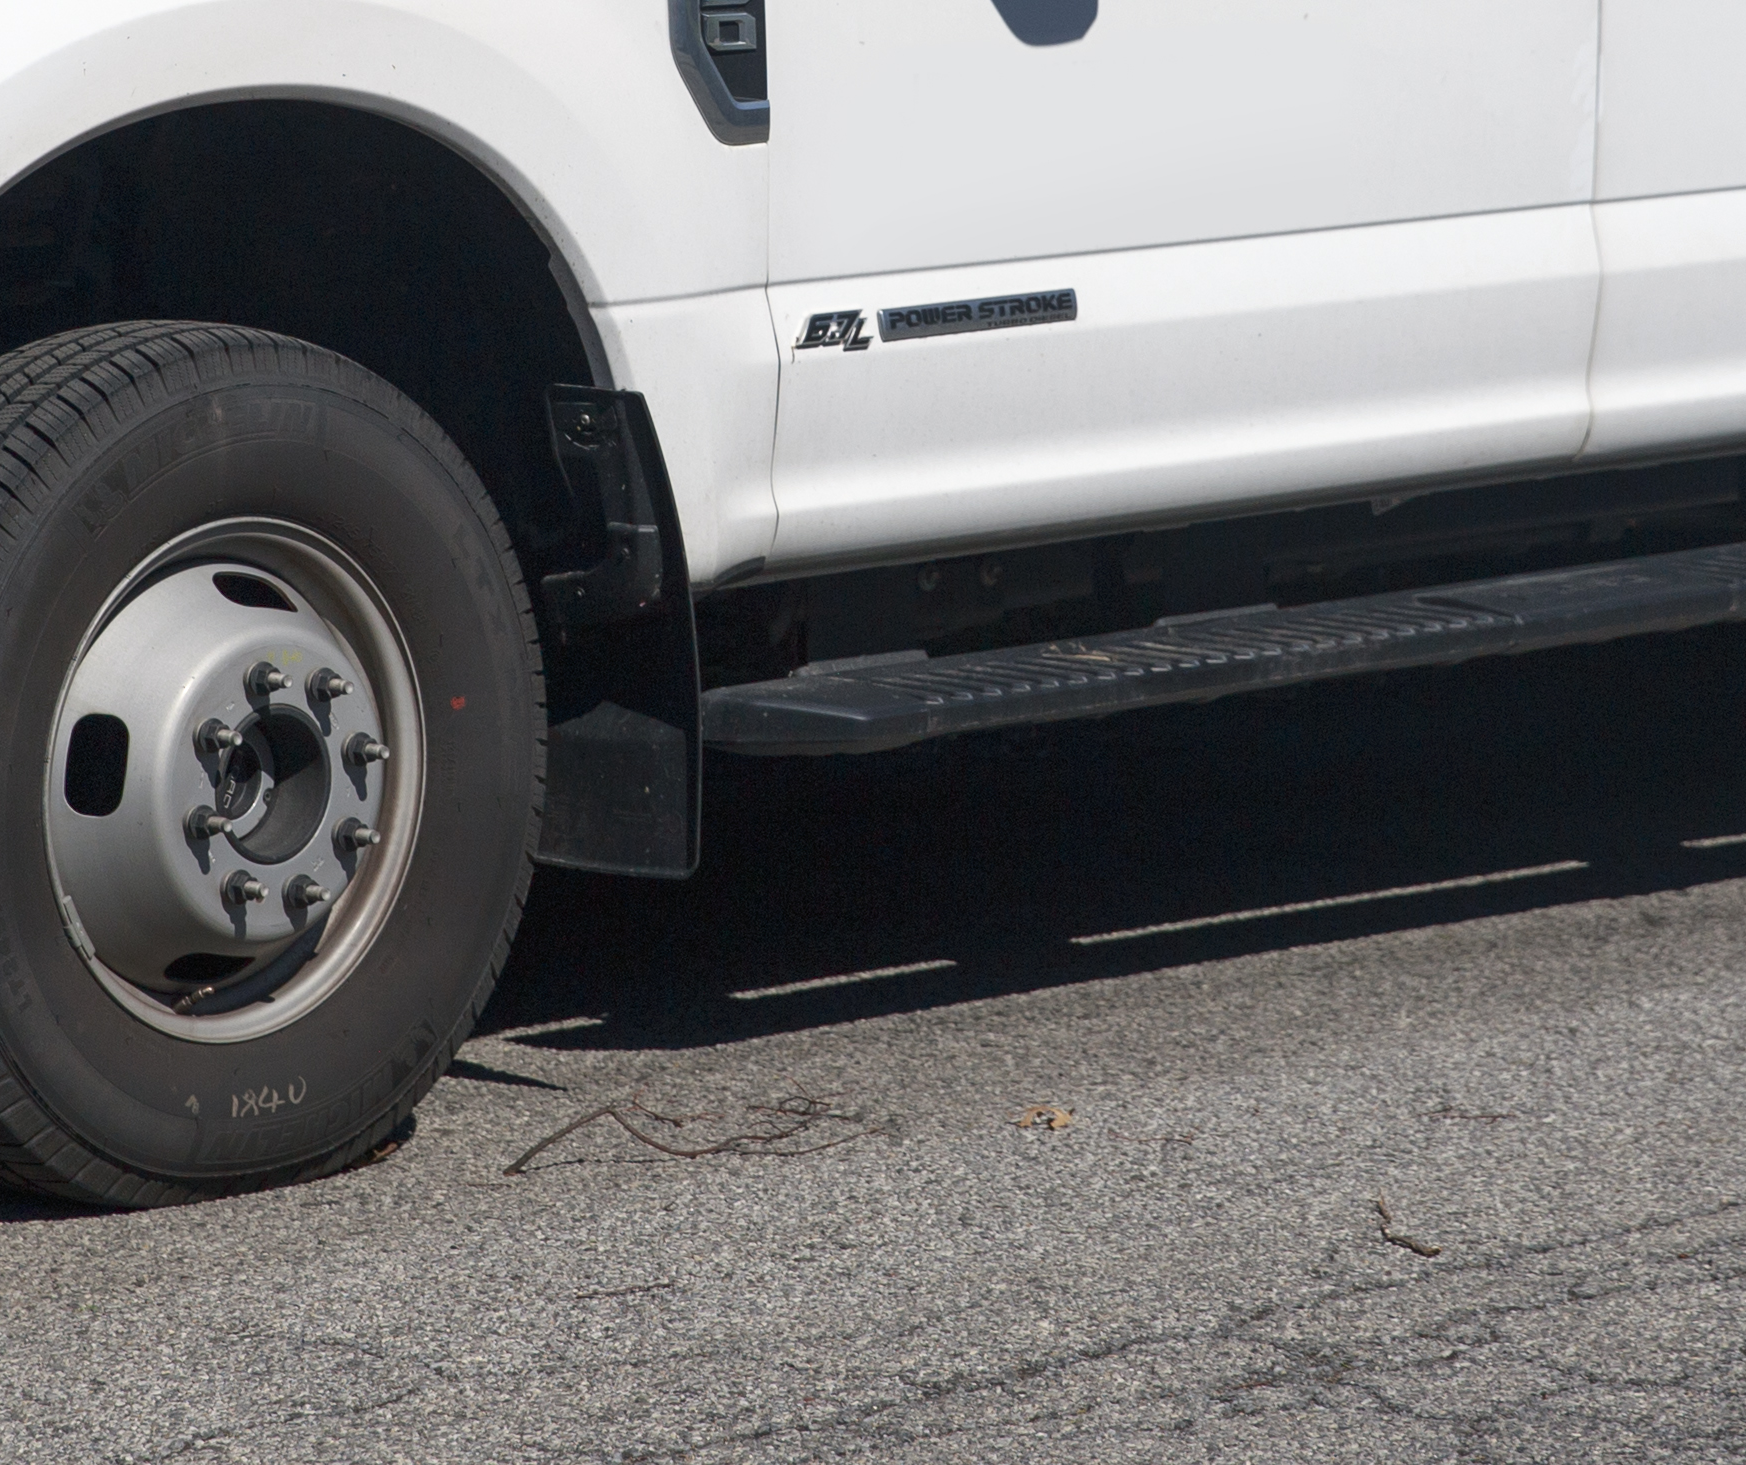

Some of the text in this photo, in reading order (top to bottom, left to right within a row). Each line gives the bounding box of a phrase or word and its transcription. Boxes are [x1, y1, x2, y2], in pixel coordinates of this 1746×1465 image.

[888, 303, 973, 330] POWER
[978, 292, 1074, 319] STROKE
[986, 312, 1073, 328] TURBO DIESEL
[119, 397, 317, 493] MICHELIN
